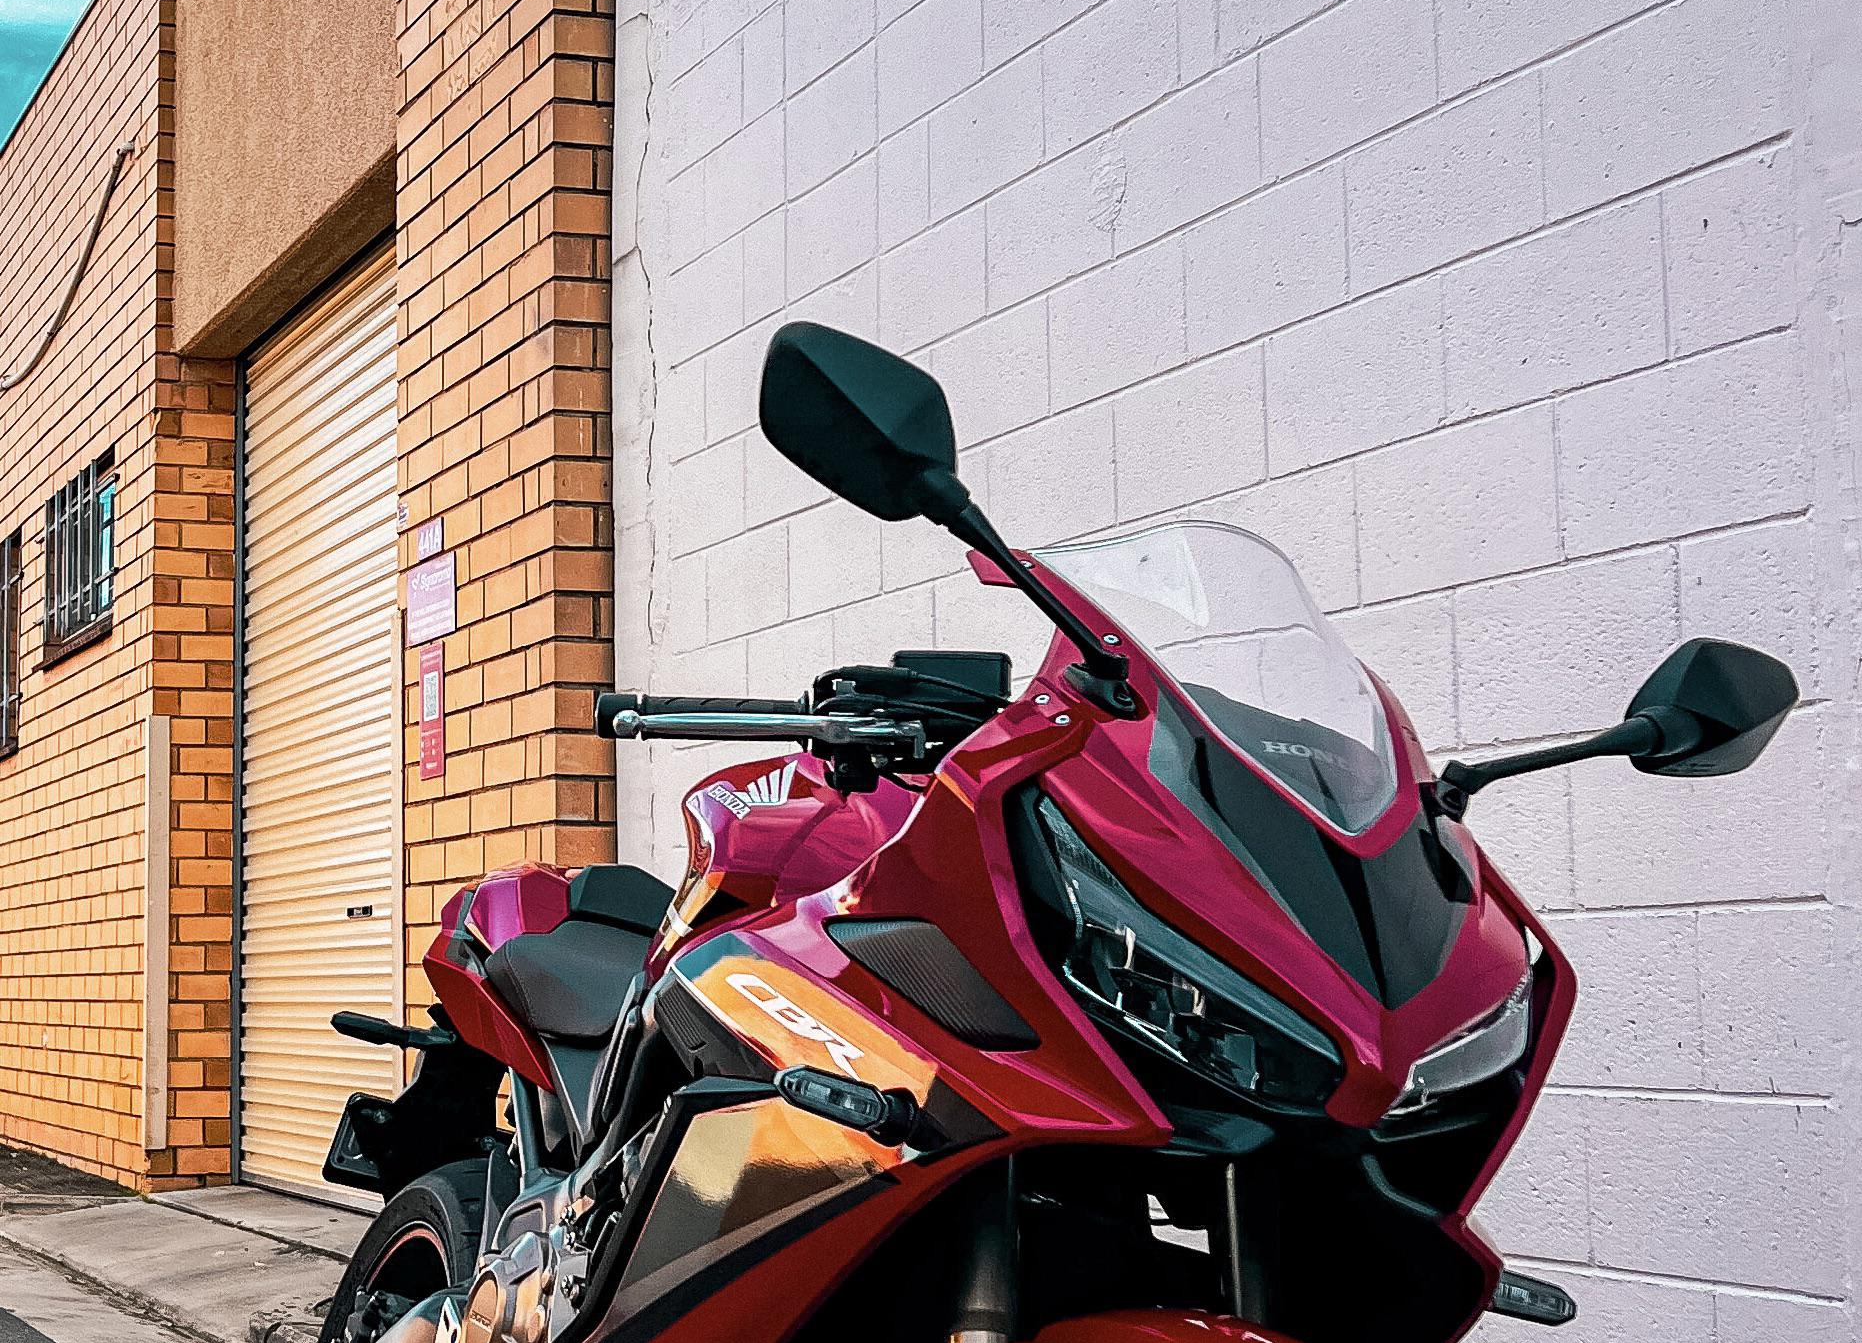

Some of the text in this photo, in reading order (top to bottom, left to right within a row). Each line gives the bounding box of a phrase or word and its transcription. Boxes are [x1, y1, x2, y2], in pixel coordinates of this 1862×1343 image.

[418, 524, 442, 555] 441A
[707, 784, 751, 820] HONDA
[725, 971, 867, 1082] CBR
